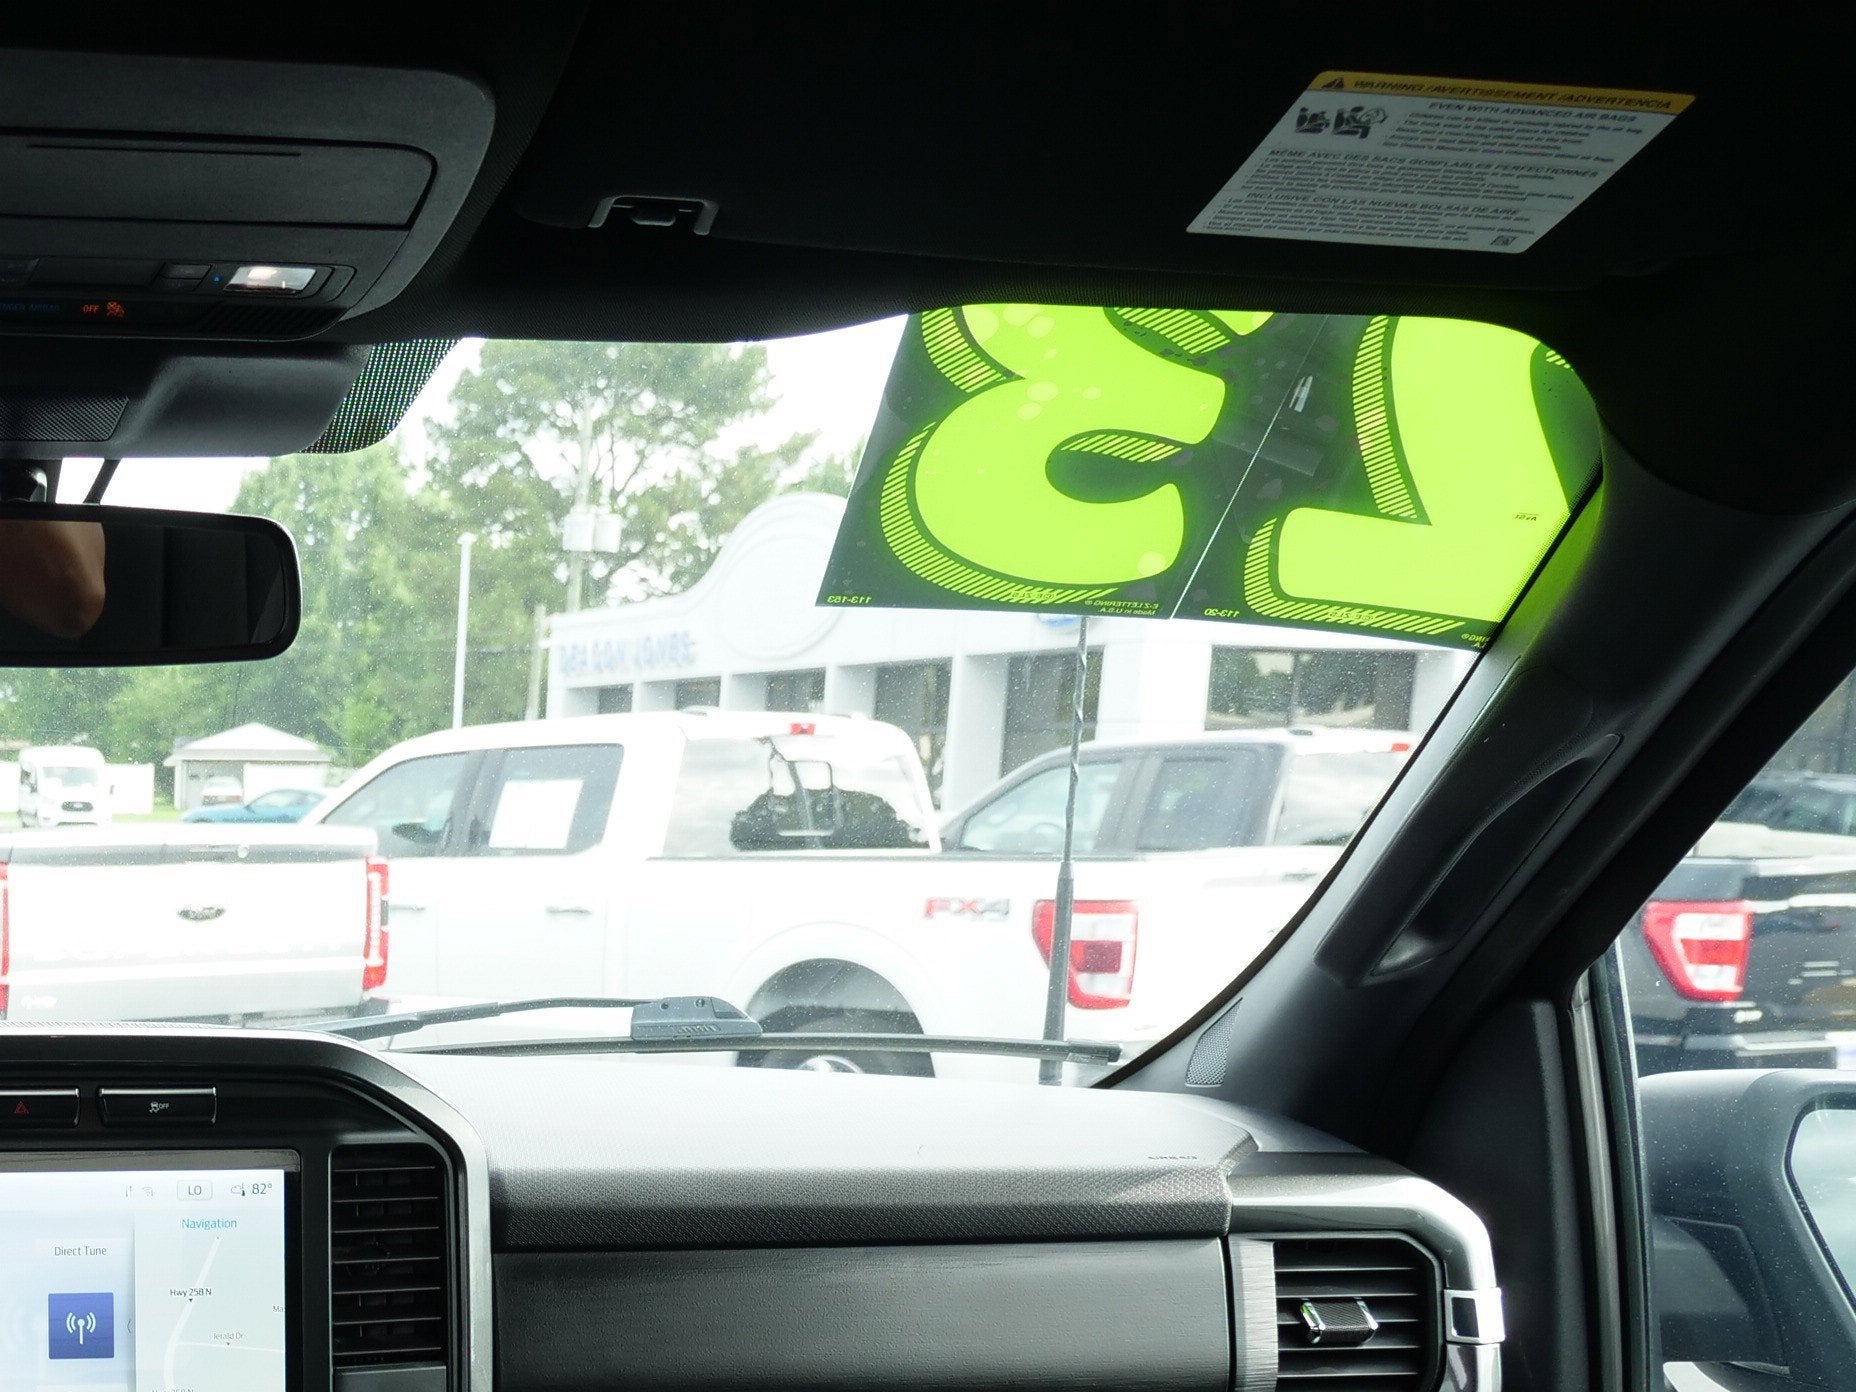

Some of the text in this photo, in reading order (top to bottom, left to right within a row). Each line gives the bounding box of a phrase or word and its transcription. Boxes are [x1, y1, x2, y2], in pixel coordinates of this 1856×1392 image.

[82, 304, 100, 313] OFF
[923, 897, 1011, 920] FX4
[187, 1184, 202, 1195] LO
[252, 1183, 273, 1195] 82°
[181, 1218, 237, 1230] Navigation
[54, 1245, 107, 1256] Direct Tune
[169, 1287, 212, 1298] Hwy 258 N
